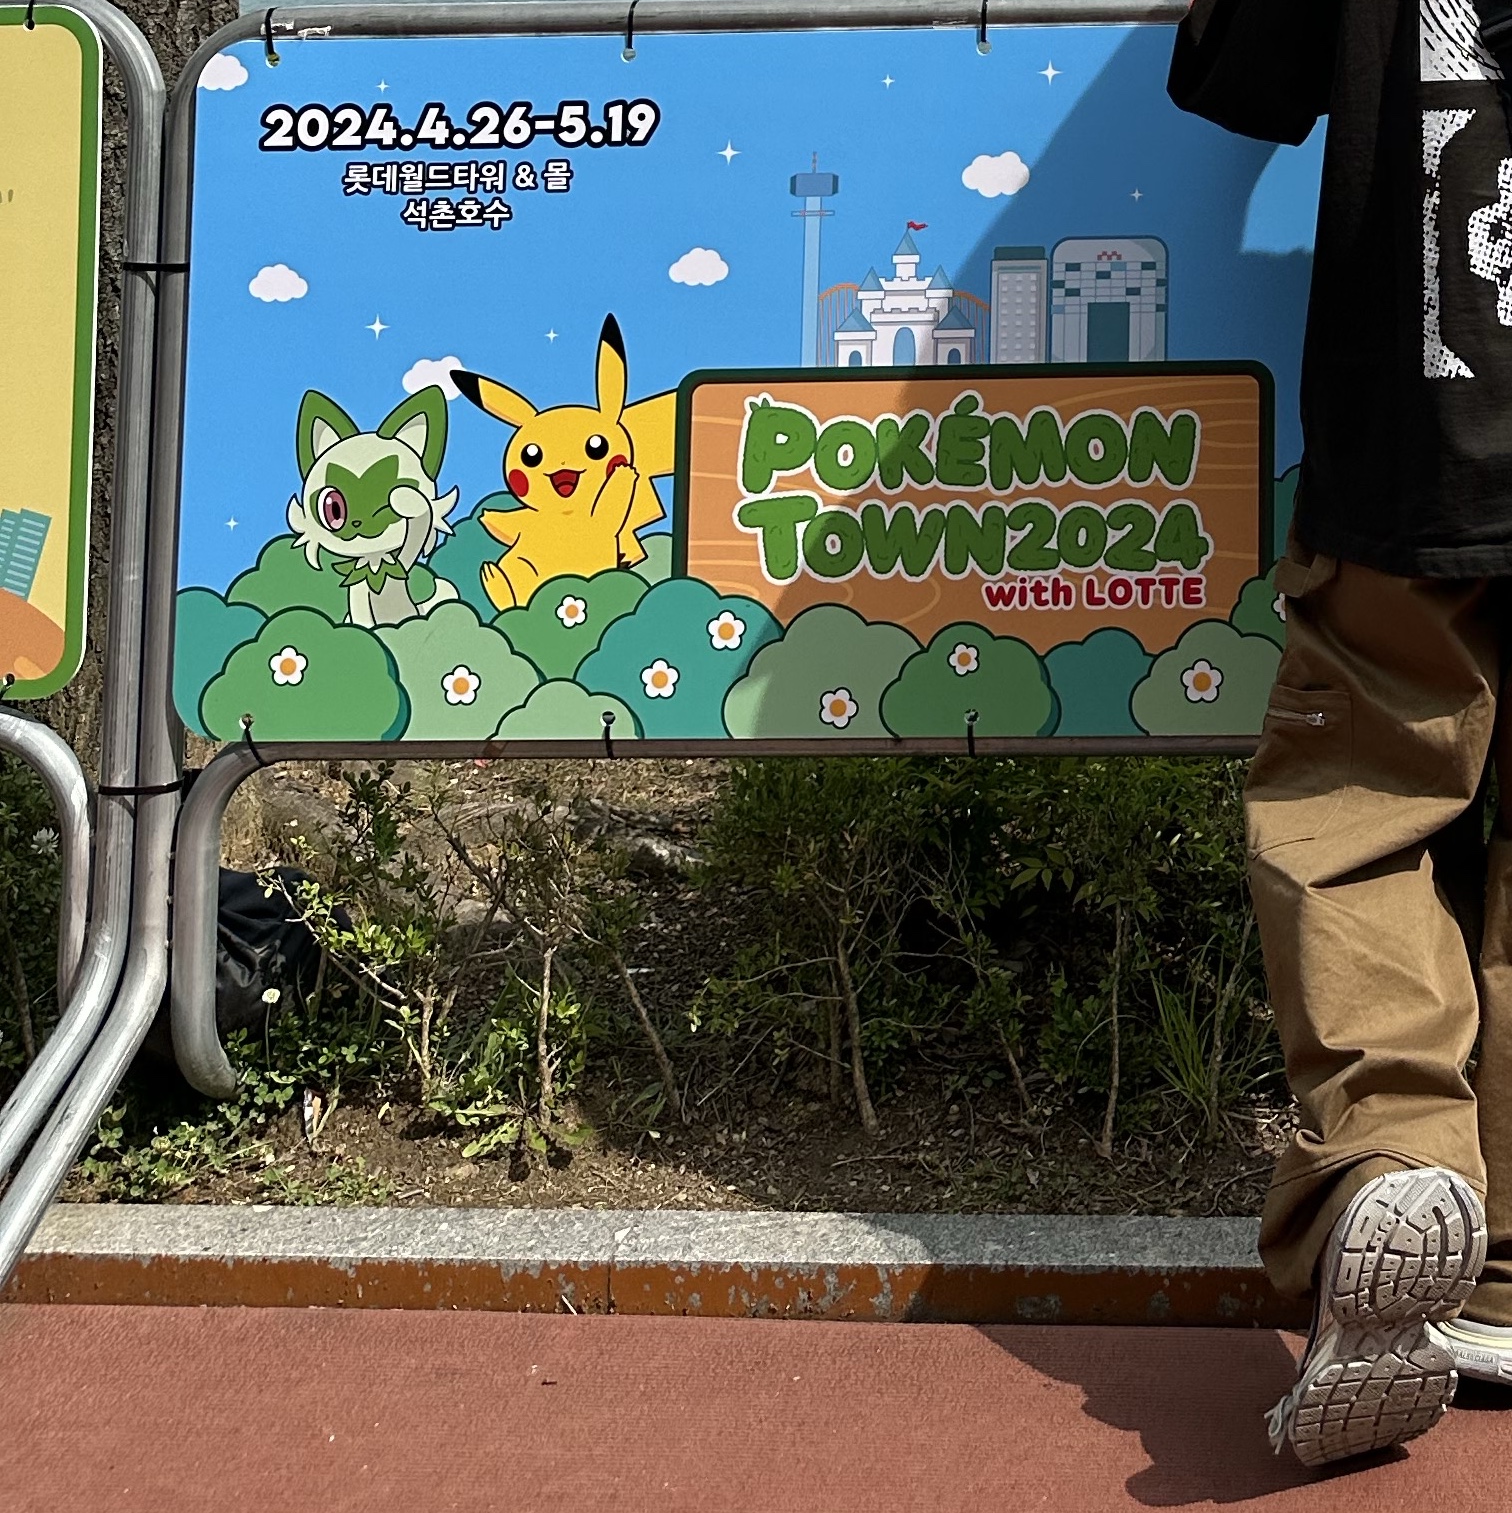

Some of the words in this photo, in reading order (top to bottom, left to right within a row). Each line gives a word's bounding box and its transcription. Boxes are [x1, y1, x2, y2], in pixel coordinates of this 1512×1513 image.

[260, 102, 660, 152] 2024.4.26-5.19
[343, 162, 507, 193] 롯데월드타워
[515, 166, 536, 189] &
[543, 162, 573, 192] 몰
[402, 198, 512, 230] 석촌호수
[736, 393, 1203, 498] POKÉMON
[984, 577, 1074, 609] with
[1084, 575, 1205, 609] LOTTE
